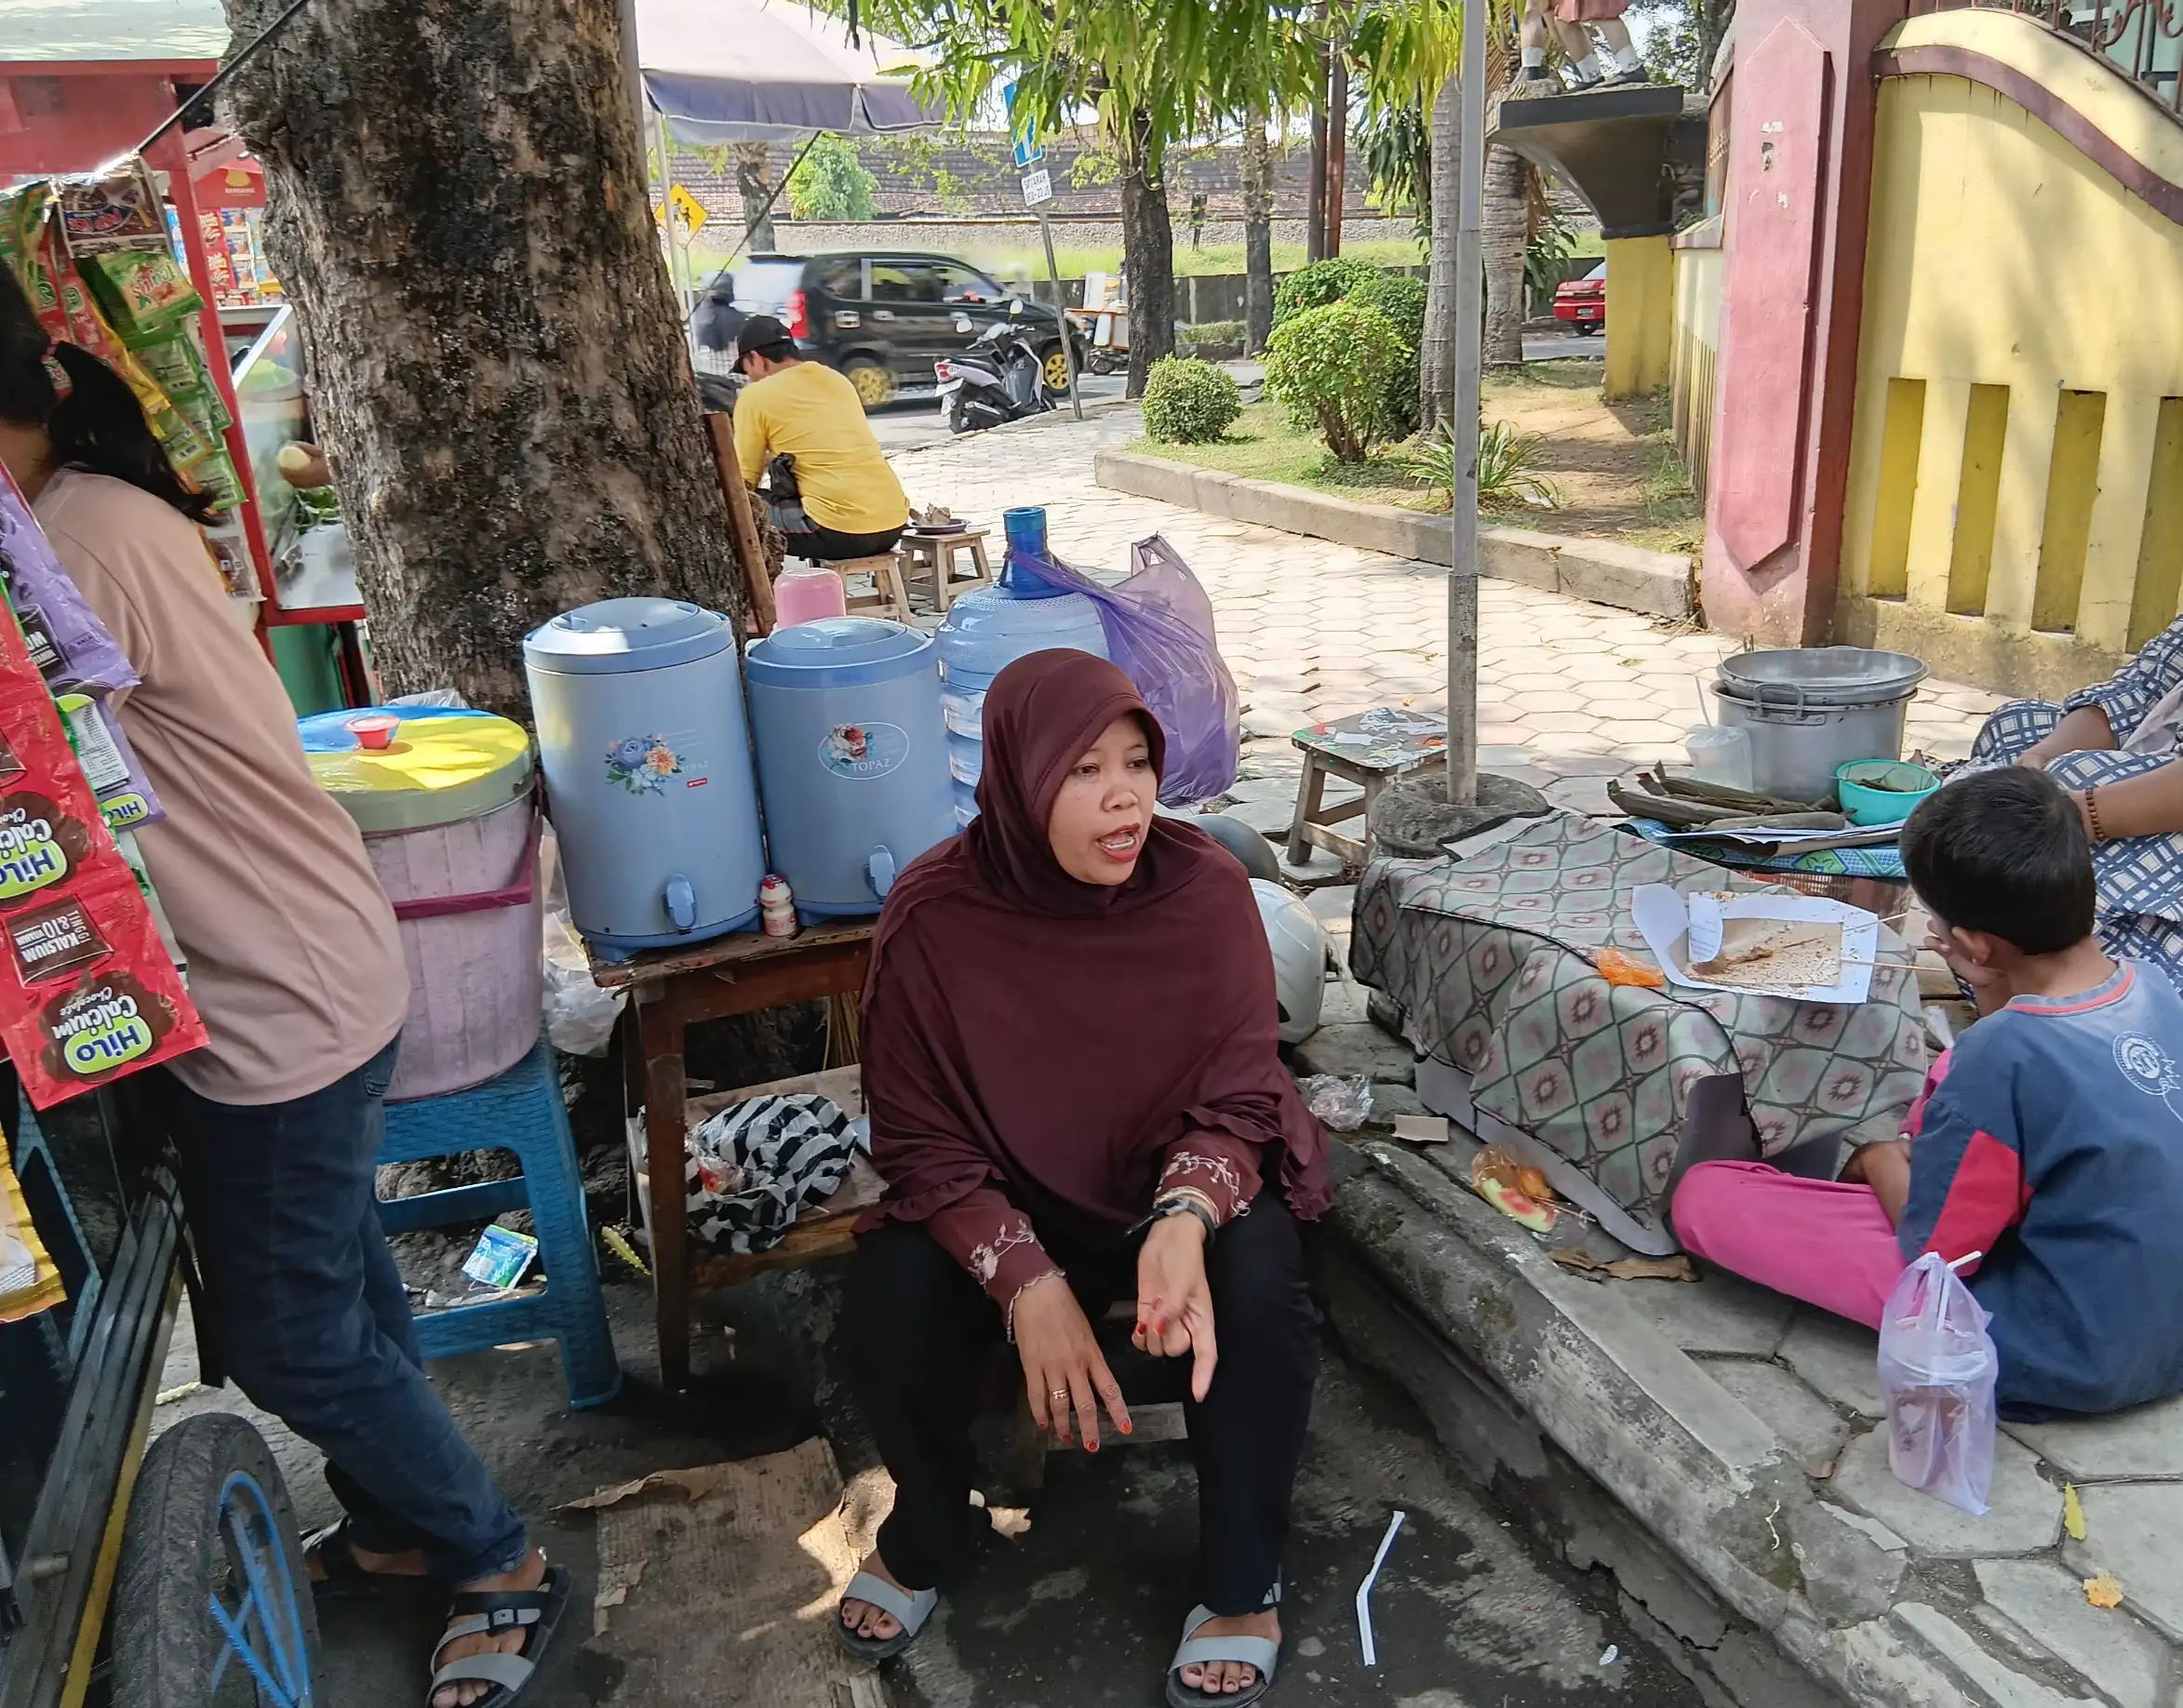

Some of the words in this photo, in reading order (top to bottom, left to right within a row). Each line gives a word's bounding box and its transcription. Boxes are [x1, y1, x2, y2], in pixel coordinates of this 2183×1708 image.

[851, 758, 891, 771] TOPAZ
[15, 929, 46, 946] VITAMIN
[66, 910, 92, 943] TINGGI
[20, 932, 81, 963] KALSIUM
[51, 994, 138, 1040] Calcium
[60, 986, 114, 1017] Chocolate
